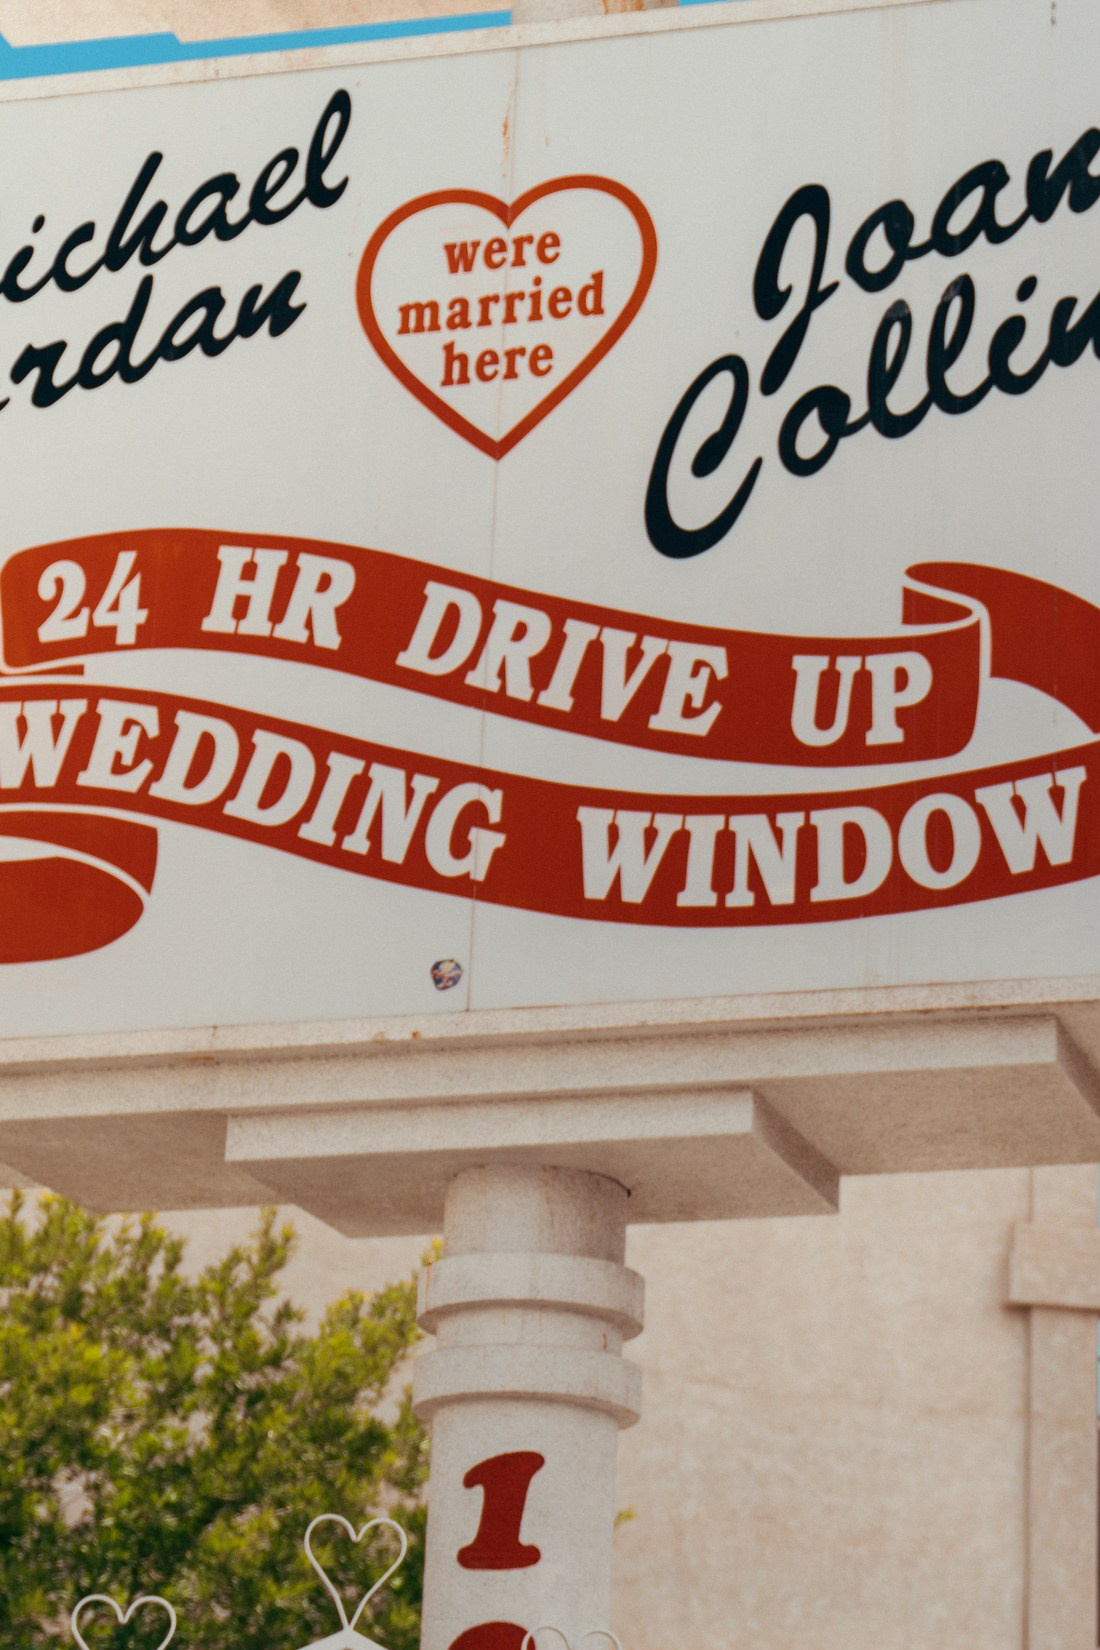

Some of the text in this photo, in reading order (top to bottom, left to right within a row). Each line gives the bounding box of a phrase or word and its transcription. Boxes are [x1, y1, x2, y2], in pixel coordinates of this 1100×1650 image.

[396, 269, 605, 336] married
[444, 230, 562, 275] were
[0, 270, 307, 411] rdan
[440, 339, 555, 387] here
[37, 544, 933, 747] 24 HR DRIVE UP
[0, 698, 1087, 908] WEDDING WINDOW
